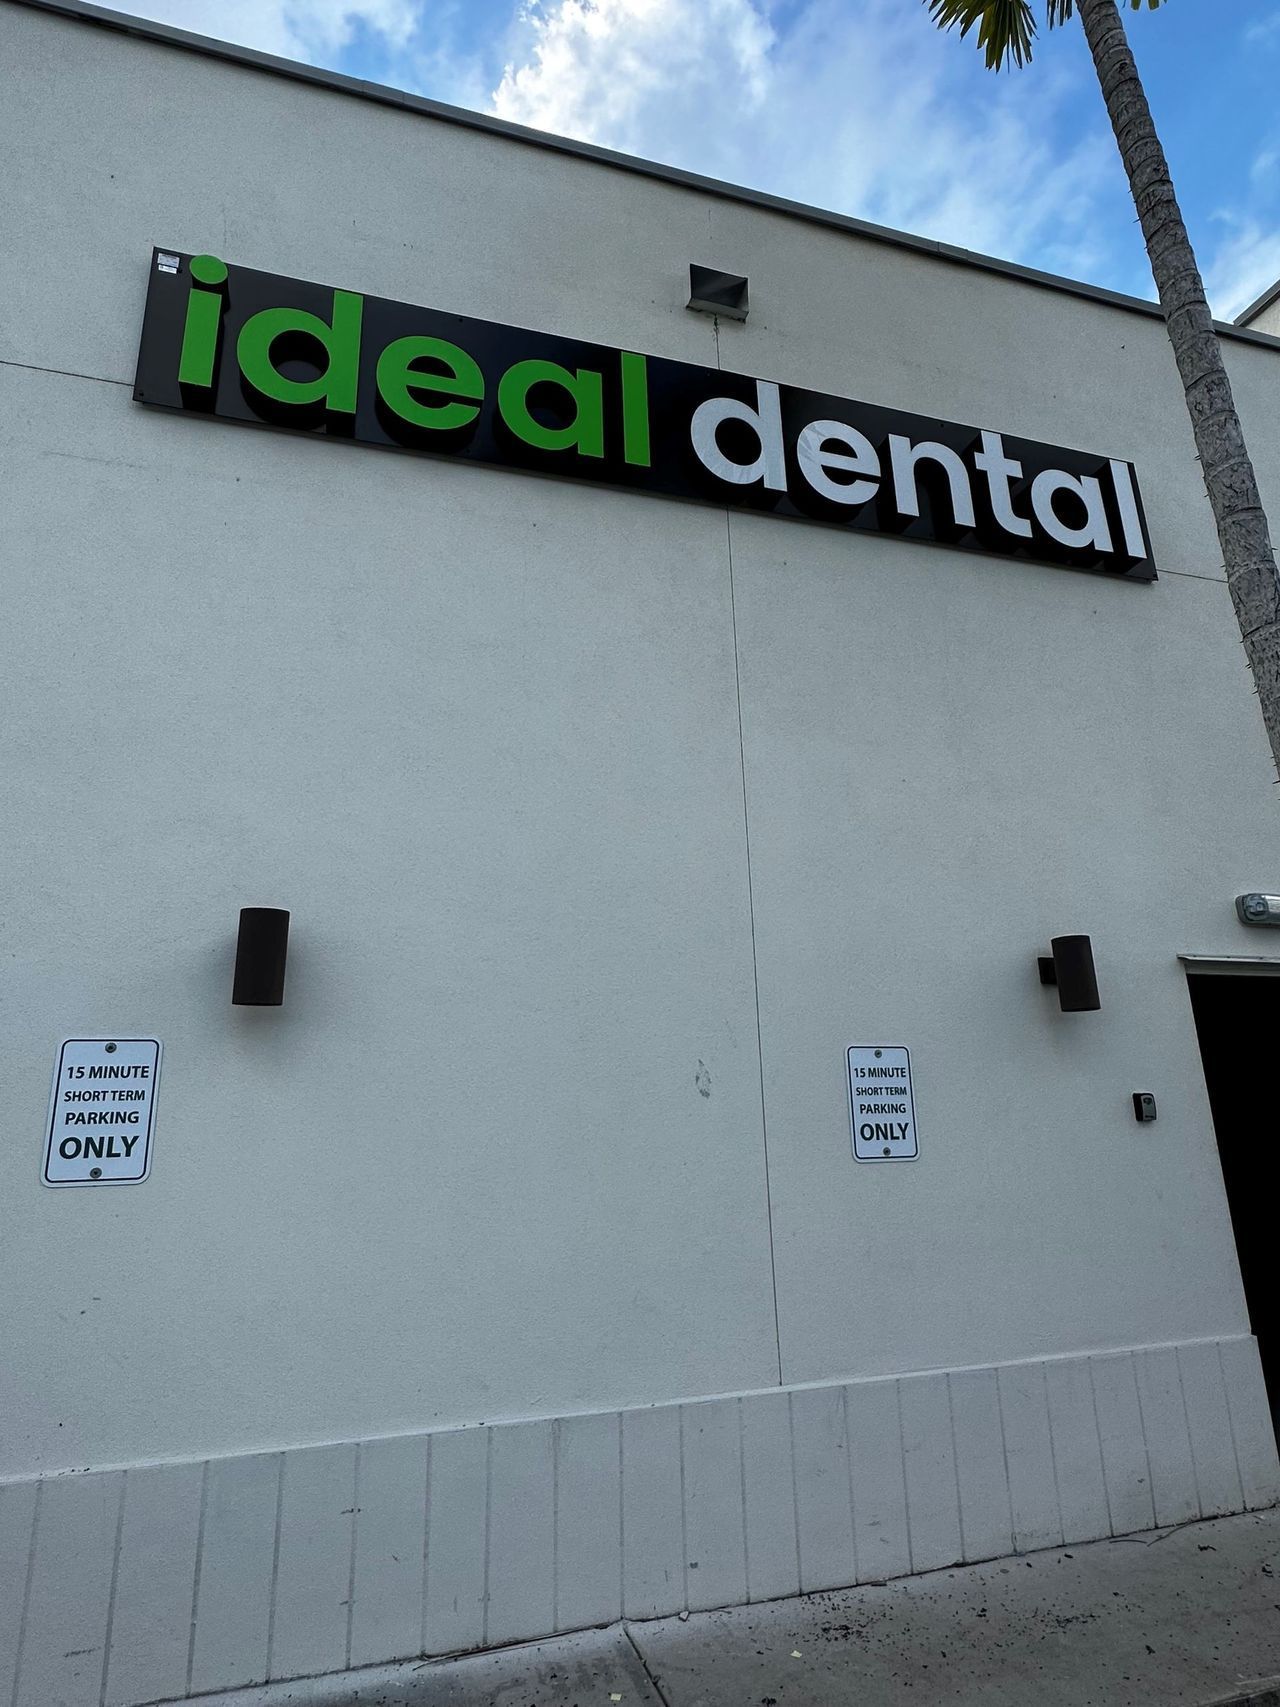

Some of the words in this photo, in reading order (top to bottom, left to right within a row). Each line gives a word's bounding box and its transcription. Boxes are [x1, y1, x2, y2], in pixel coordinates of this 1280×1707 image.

[178, 254, 651, 467] ideal
[690, 379, 1147, 559] dental
[67, 1066, 85, 1079] 15
[88, 1065, 150, 1079] MINUTE
[854, 1067, 866, 1078] 15
[868, 1067, 907, 1078] MINUTE
[64, 1090, 108, 1102] SHORT
[110, 1089, 146, 1101] TERM
[856, 1086, 883, 1096] SHORT
[885, 1086, 907, 1096] TERM
[859, 1103, 907, 1114] PARKING
[64, 1111, 140, 1125] PARKING
[860, 1122, 909, 1141] ONLY
[59, 1135, 140, 1160] ONLY
